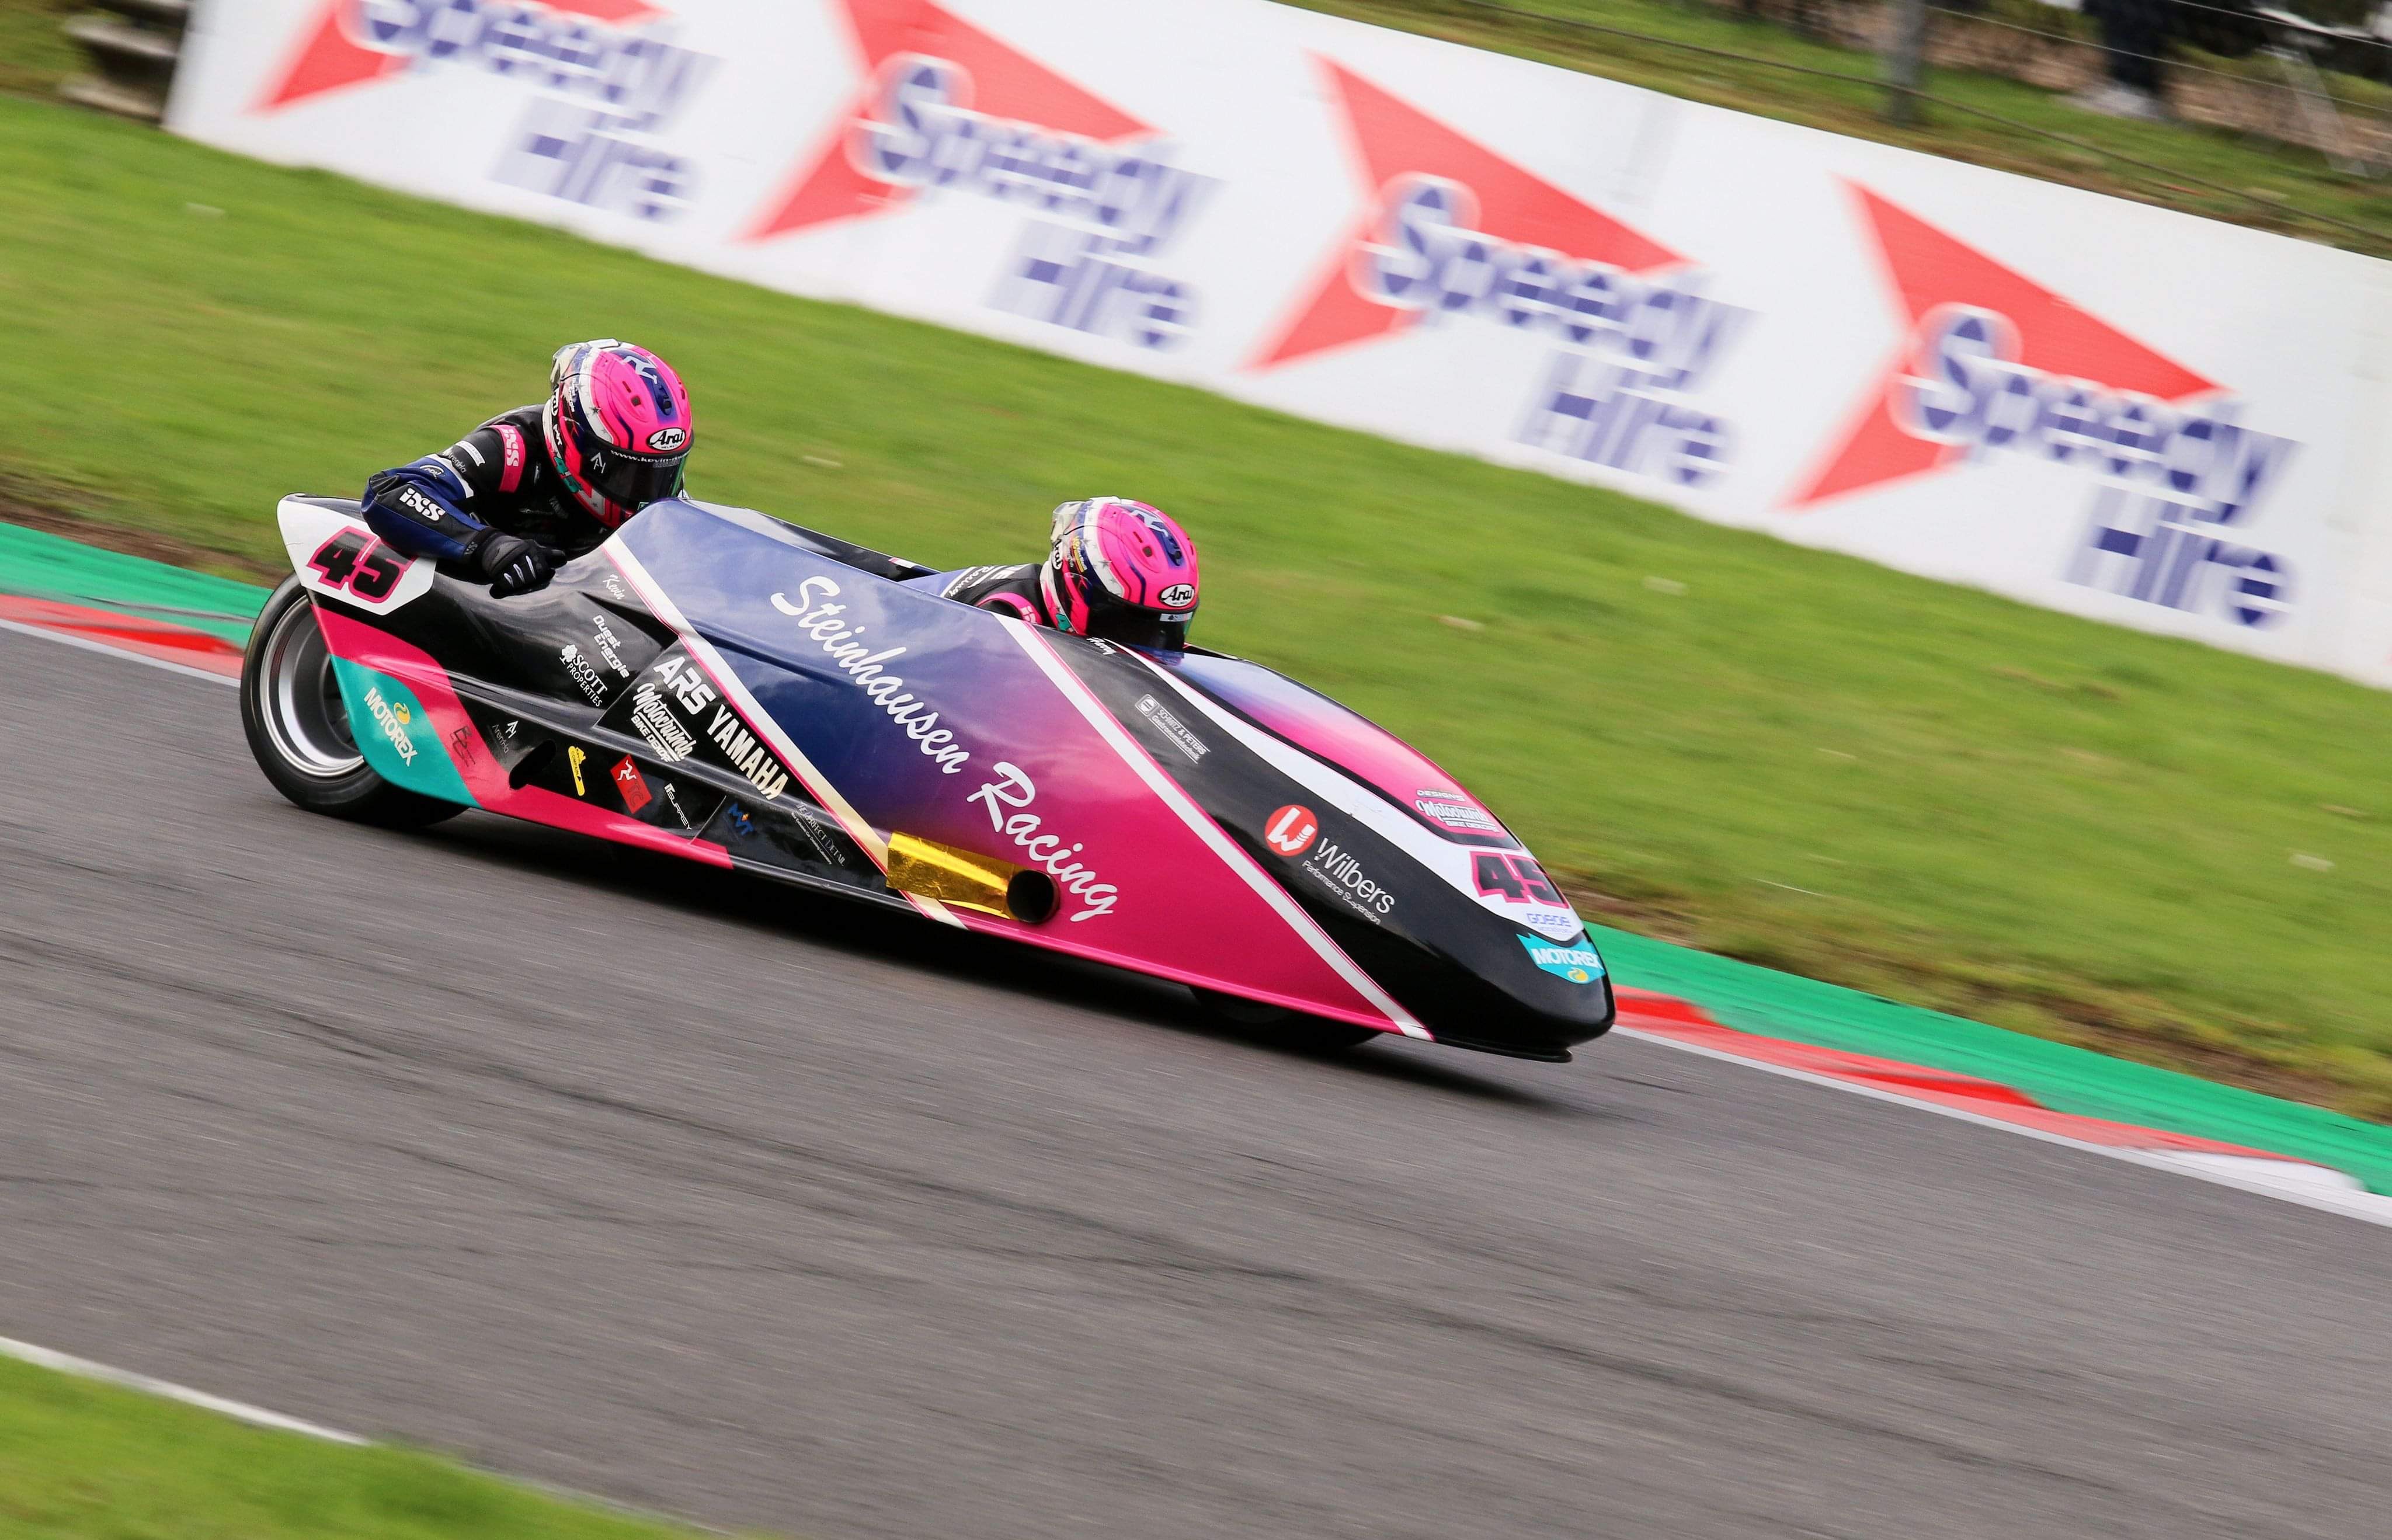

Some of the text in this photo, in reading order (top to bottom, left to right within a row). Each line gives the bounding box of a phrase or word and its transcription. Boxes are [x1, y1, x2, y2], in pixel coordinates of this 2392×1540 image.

[490, 96, 704, 225] Hire
[867, 61, 1226, 255] Speedy
[982, 216, 1202, 350] Hire
[1369, 184, 1763, 394] Speedy
[649, 429, 685, 446] Arai
[1511, 349, 1736, 486] Hire
[1913, 313, 2306, 527] Speedy
[399, 488, 446, 521] iXS
[306, 526, 419, 603] 45
[603, 574, 625, 600] Kevin
[2061, 482, 2299, 630] Hire
[1160, 586, 1194, 602] Arai
[566, 663, 602, 707] PROPERTIES
[573, 655, 607, 694] SCOTT
[594, 632, 630, 678] Energie
[653, 656, 717, 715] ARS
[364, 687, 418, 766] MOTOREX
[631, 715, 651, 736] BIKE
[707, 704, 788, 799] YAMAHA
[771, 576, 1118, 922] Steinhausen Racing
[1183, 733, 1207, 755] PETERS
[1416, 789, 1465, 802] DESIGNS
[1302, 860, 1381, 925] Performance Suspension
[1314, 837, 1395, 913] Wilbers
[1470, 851, 1570, 909] 45
[1531, 947, 1604, 970] MOTOREX
